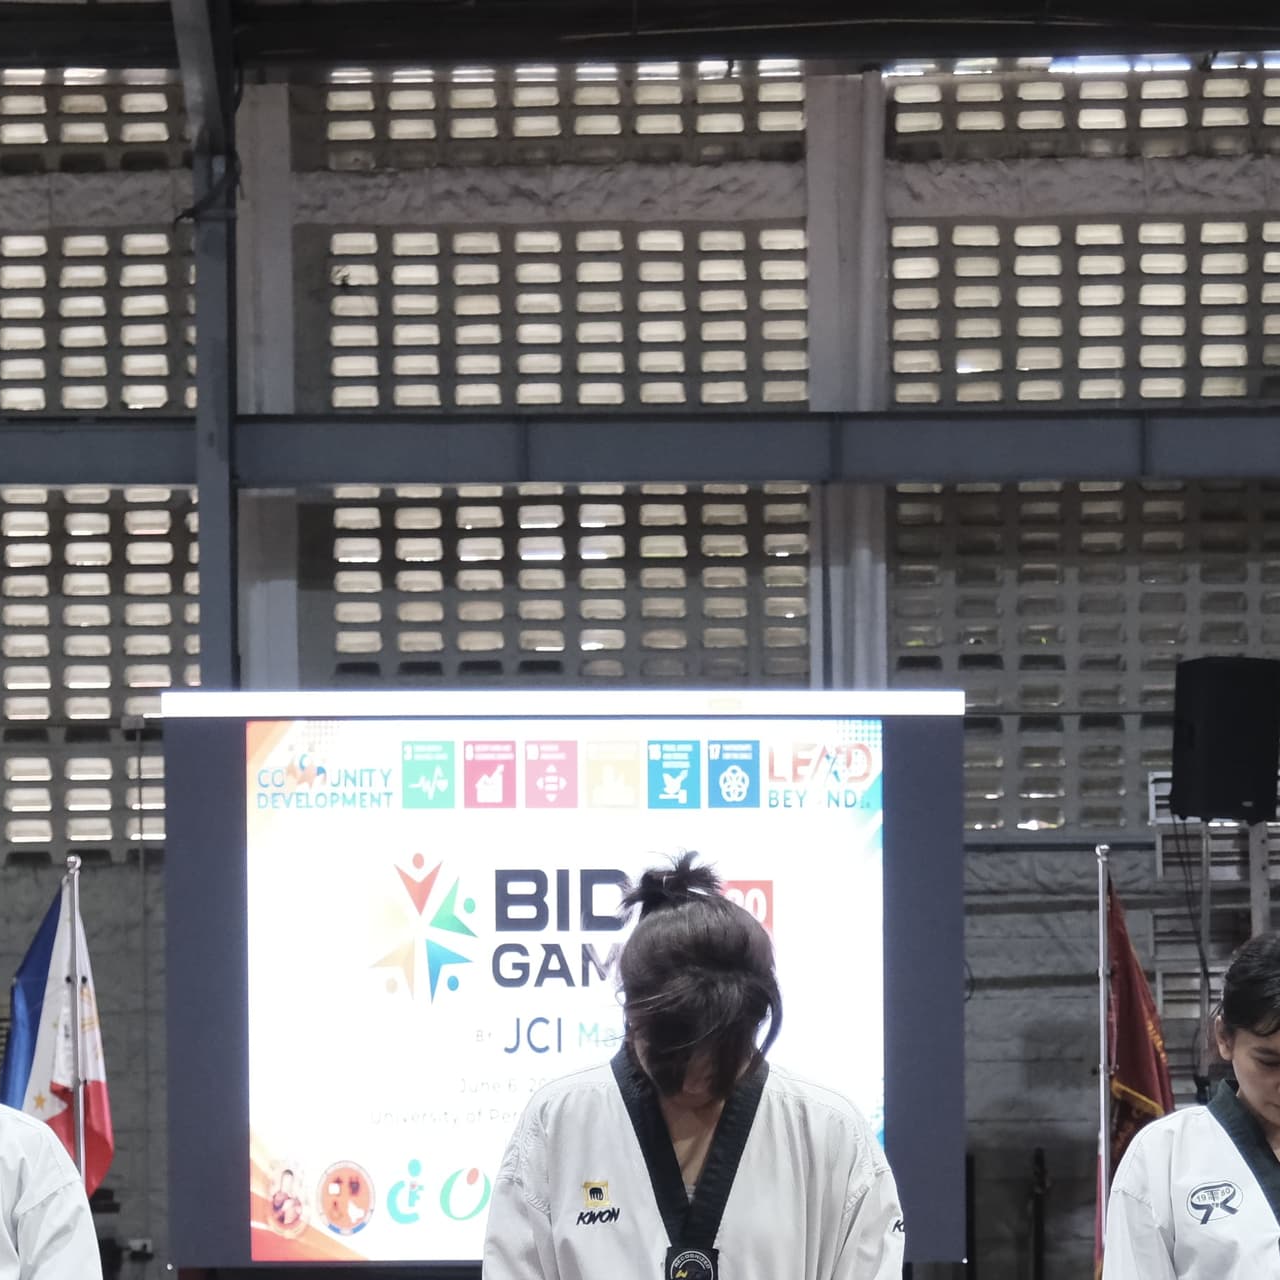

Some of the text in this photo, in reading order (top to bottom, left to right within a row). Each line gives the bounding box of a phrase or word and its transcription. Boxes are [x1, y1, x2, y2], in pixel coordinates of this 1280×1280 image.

[256, 792, 394, 809] DEVELOPMENT
[494, 869, 632, 932] BID
[492, 943, 622, 989] GAM
[504, 1016, 562, 1054] JCI
[576, 1207, 621, 1226] KWON
